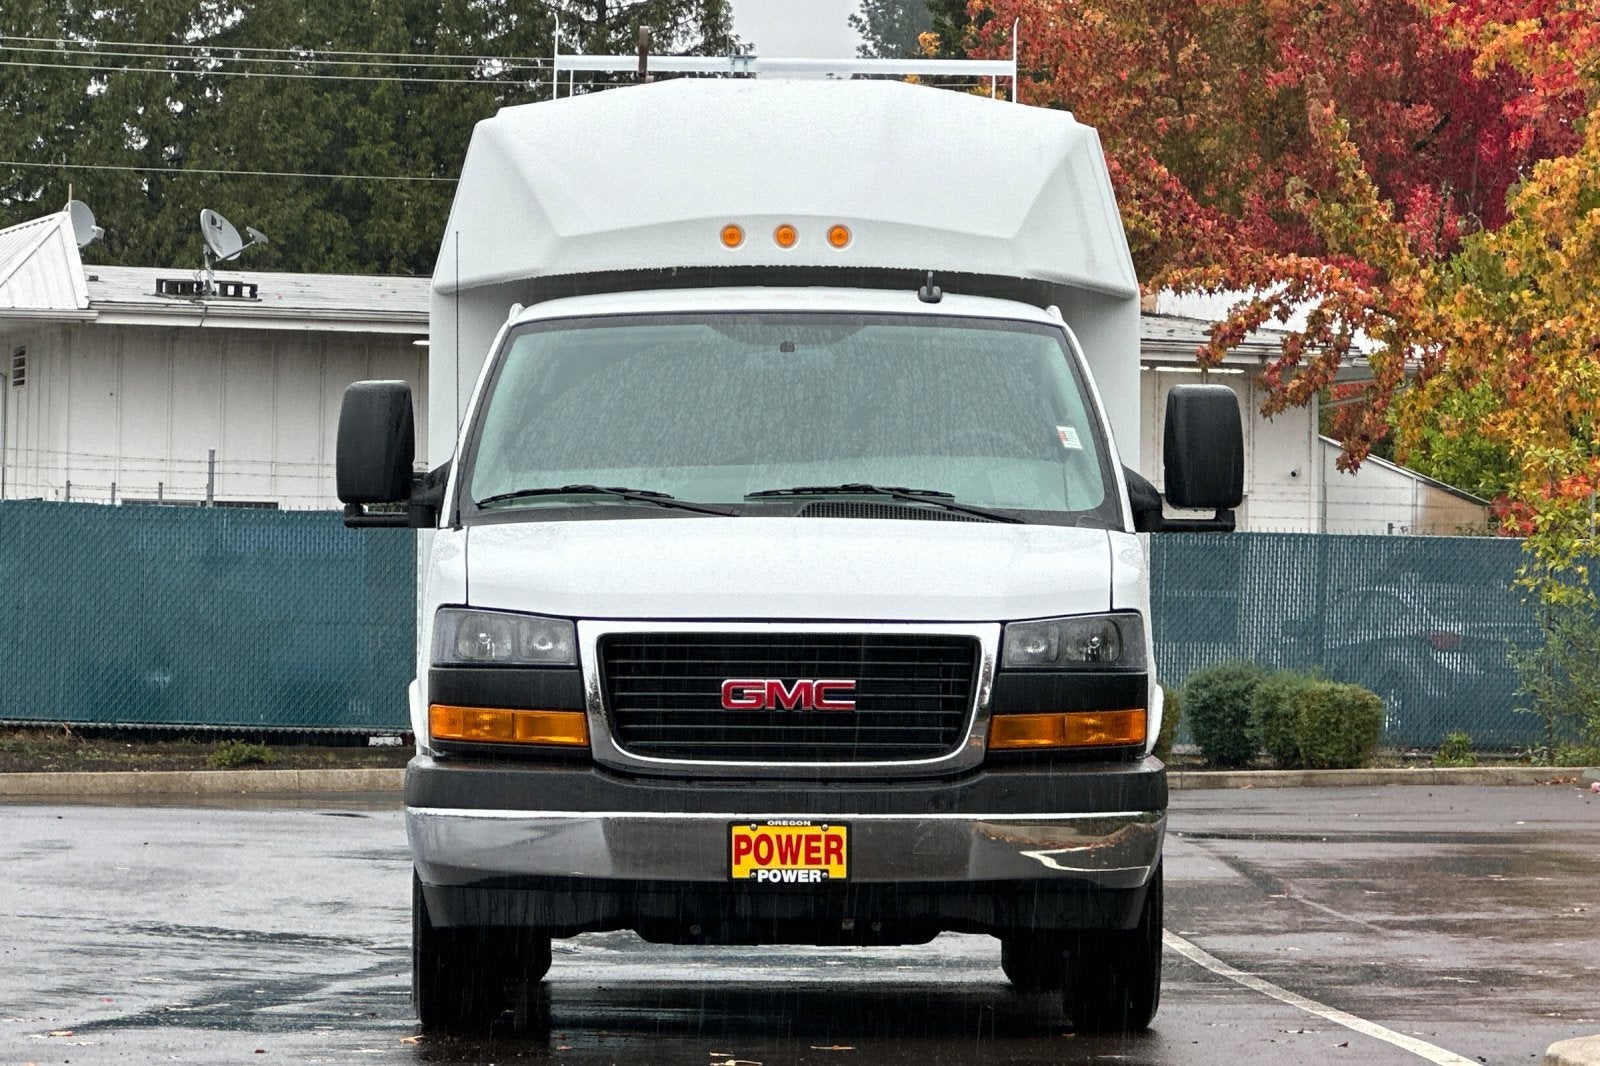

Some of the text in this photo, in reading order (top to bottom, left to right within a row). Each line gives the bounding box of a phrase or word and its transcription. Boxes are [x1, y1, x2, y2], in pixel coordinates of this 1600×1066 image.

[721, 679, 856, 711] GMC
[734, 833, 844, 866] POWER
[757, 869, 822, 883] POWER
